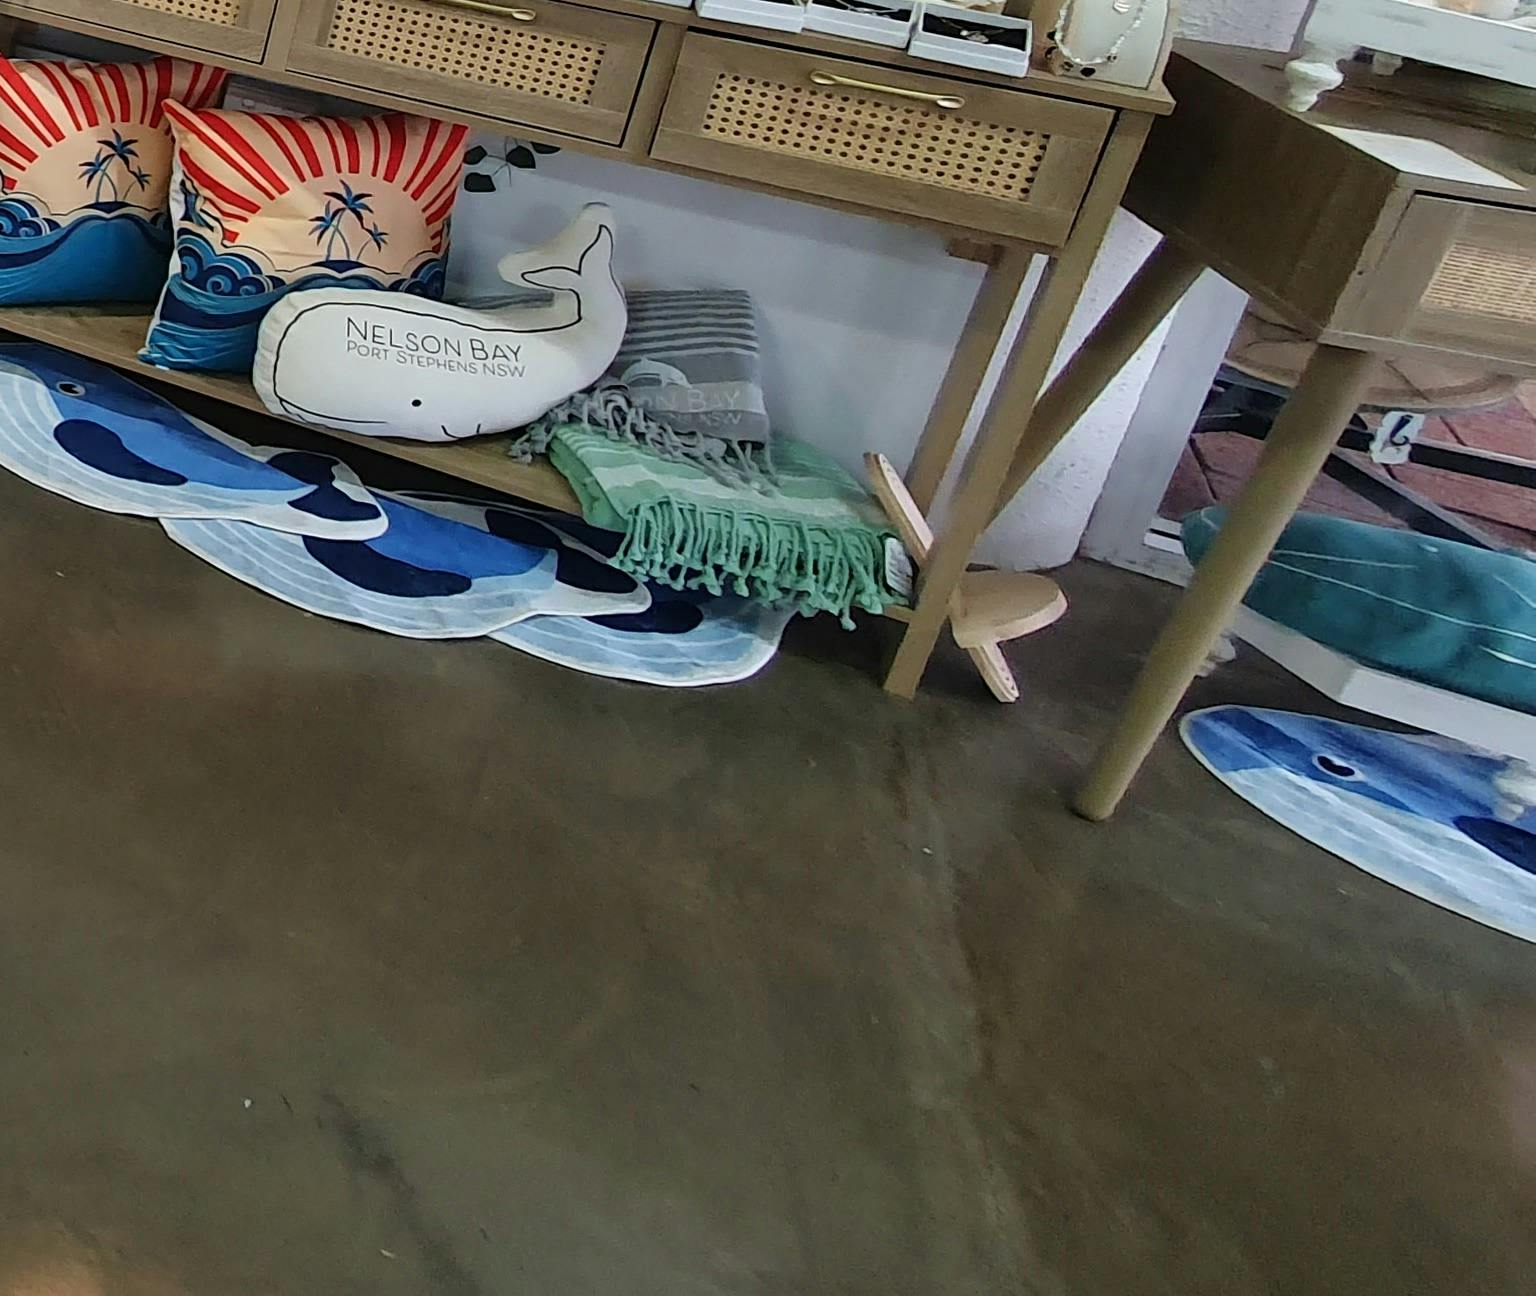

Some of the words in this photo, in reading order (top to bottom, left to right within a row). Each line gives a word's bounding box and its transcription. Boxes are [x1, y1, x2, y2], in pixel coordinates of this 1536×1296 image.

[346, 317, 462, 357] NELSON
[469, 338, 522, 362] BAY
[346, 340, 390, 361] PORT
[396, 351, 478, 375] STEPHENS
[482, 363, 526, 378] NSW
